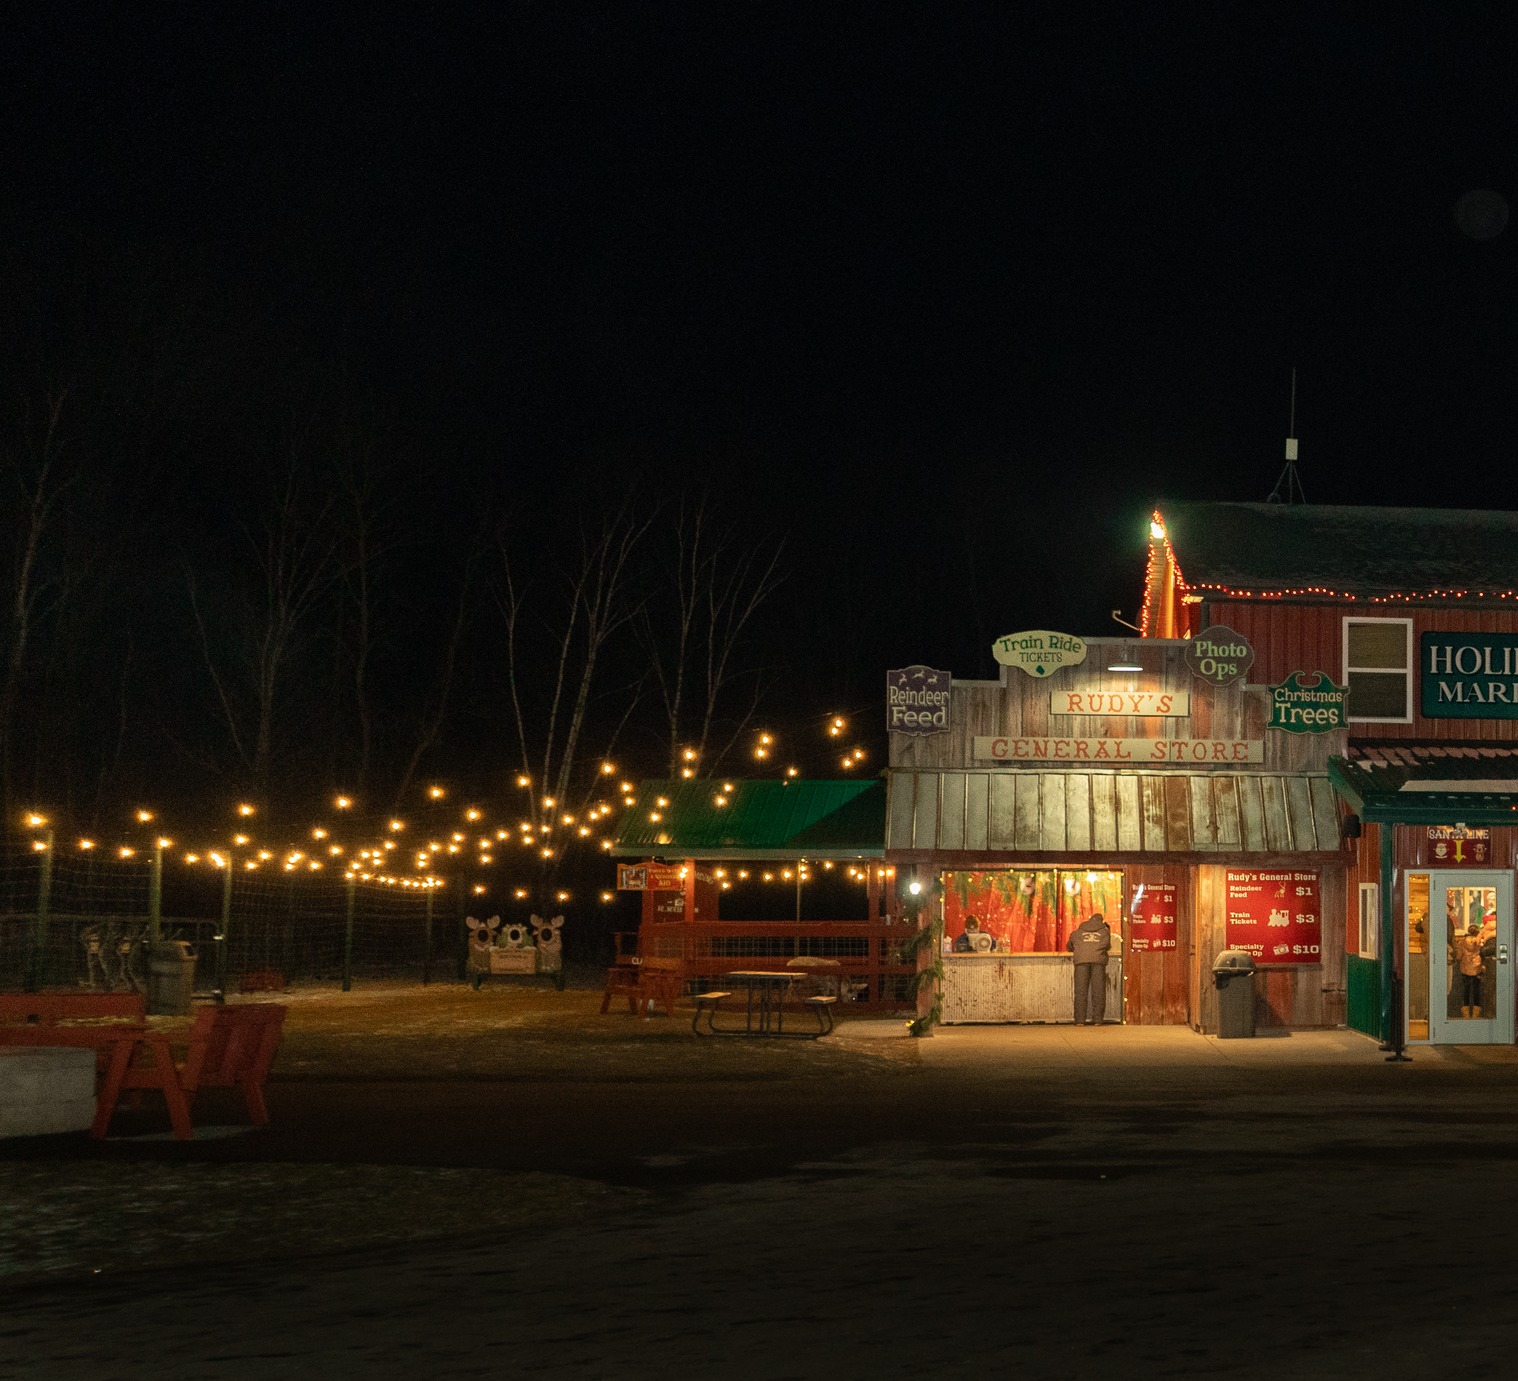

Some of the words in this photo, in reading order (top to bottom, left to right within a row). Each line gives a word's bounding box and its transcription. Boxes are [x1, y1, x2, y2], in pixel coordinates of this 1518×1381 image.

[1000, 635, 1043, 652] Train
[1049, 635, 1081, 652] Ride
[1195, 641, 1247, 657] Photo
[1019, 652, 1062, 662] TICKETS
[1200, 658, 1237, 680] Ops
[890, 686, 948, 706] Reindeer
[1274, 688, 1342, 702] Christmas
[1066, 694, 1173, 713] RUDY'S
[892, 707, 947, 727] Feed
[1275, 702, 1338, 724] Trees
[991, 739, 1131, 759] GENERAL
[1150, 741, 1249, 760] STORE
[1228, 873, 1257, 882] Rudy's
[1259, 873, 1292, 881] General
[1294, 873, 1317, 881] Store
[1295, 886, 1313, 896] $1
[1295, 913, 1315, 924] $3
[1229, 943, 1264, 951] Specialty
[1292, 944, 1319, 954] $10
